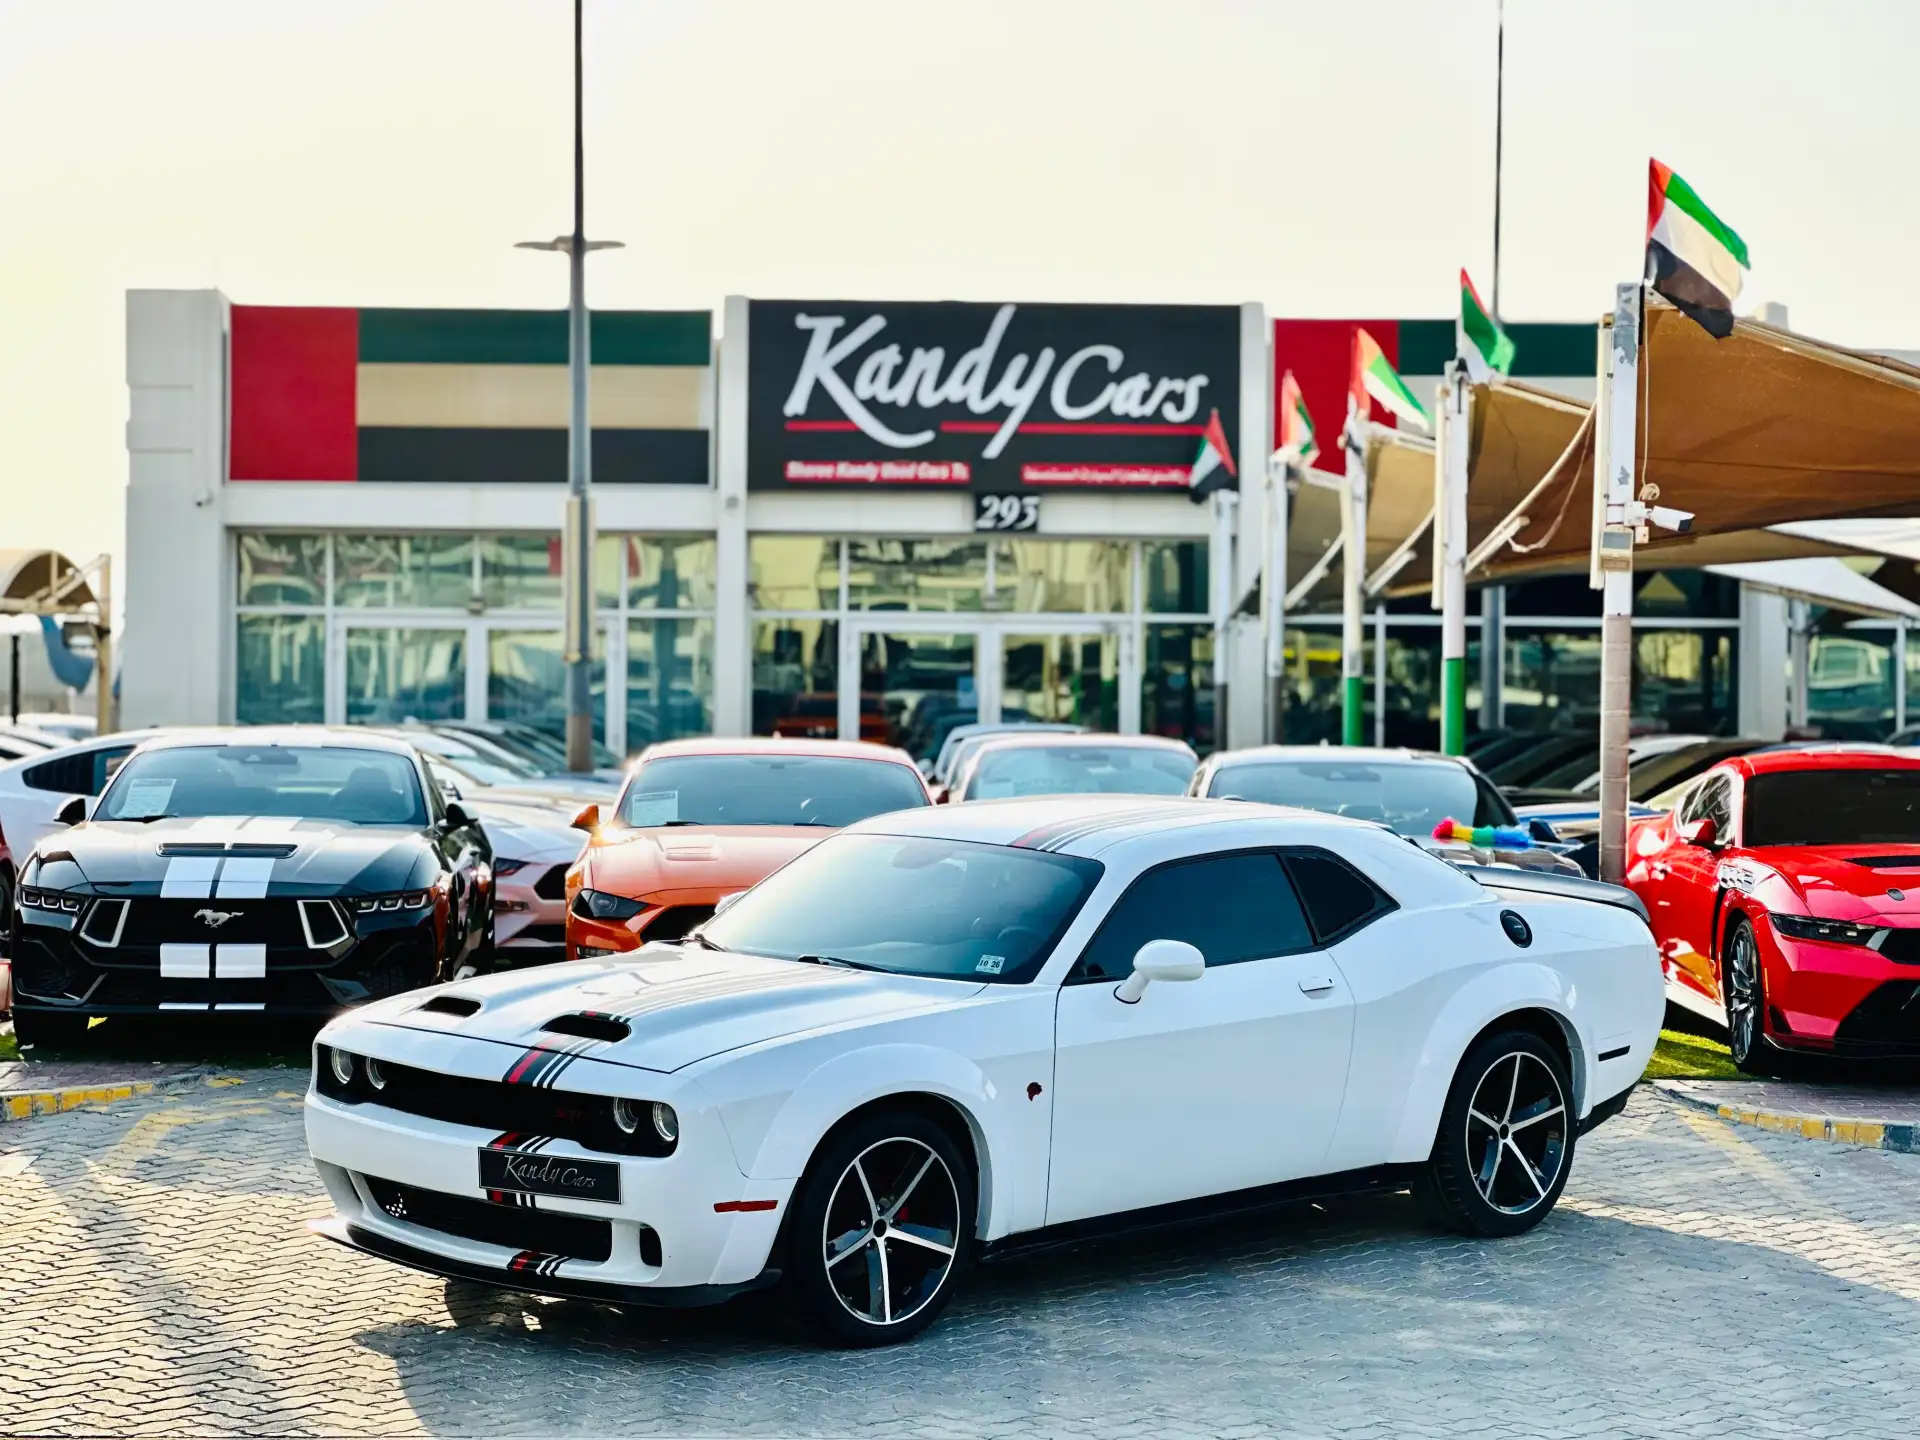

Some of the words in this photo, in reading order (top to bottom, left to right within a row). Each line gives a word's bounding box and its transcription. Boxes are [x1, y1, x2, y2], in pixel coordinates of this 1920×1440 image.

[783, 304, 1056, 459] Kandy
[1050, 344, 1209, 423] Cars
[976, 494, 1039, 530] 295
[990, 961, 1000, 969] 26
[503, 1155, 561, 1188] Kandy
[561, 1168, 597, 1188] Cars
